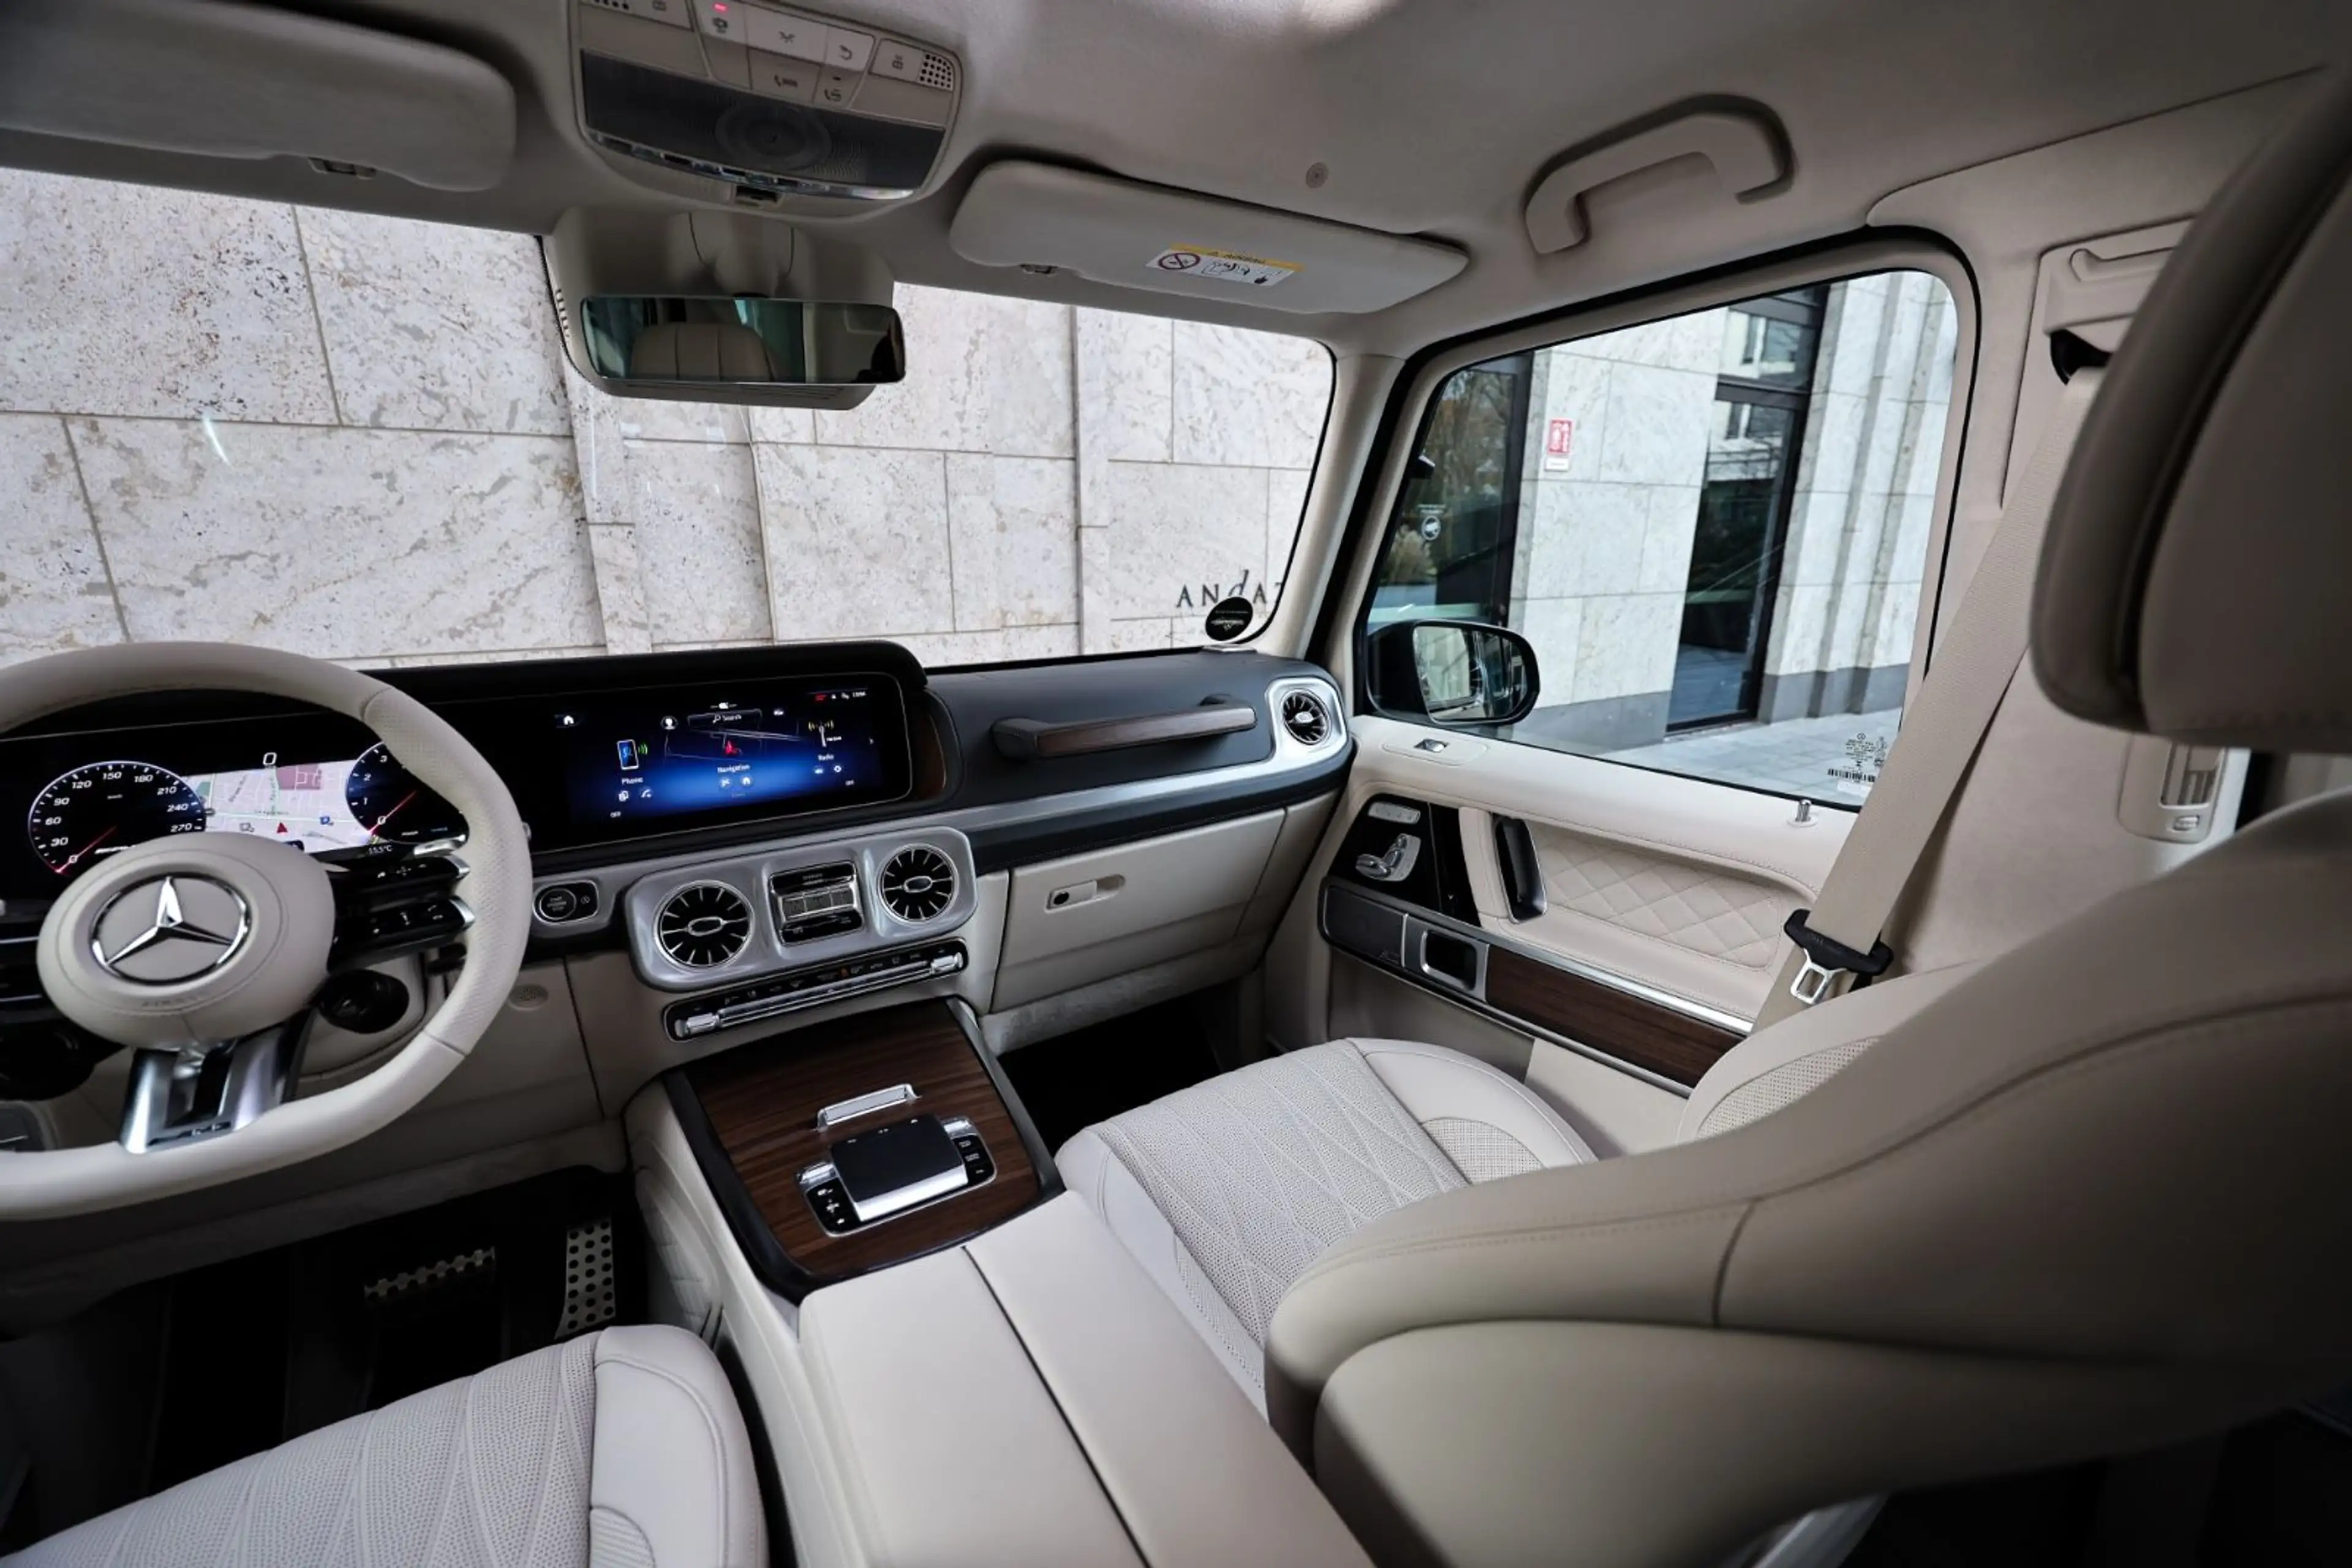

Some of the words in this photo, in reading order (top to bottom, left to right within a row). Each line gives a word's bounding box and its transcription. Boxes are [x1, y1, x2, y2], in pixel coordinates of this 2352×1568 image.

[262, 752, 277, 766] 0
[379, 755, 388, 763] 3
[717, 764, 751, 774] Navigation
[103, 771, 123, 780] 150
[134, 774, 154, 783] 180
[363, 772, 372, 782] 2
[72, 780, 92, 790] 120
[157, 786, 177, 796] 210
[53, 797, 70, 807] 90
[363, 797, 369, 806] 1
[167, 802, 189, 812] 240
[45, 816, 62, 826] 60
[170, 822, 193, 833] 270
[50, 837, 69, 847] 30
